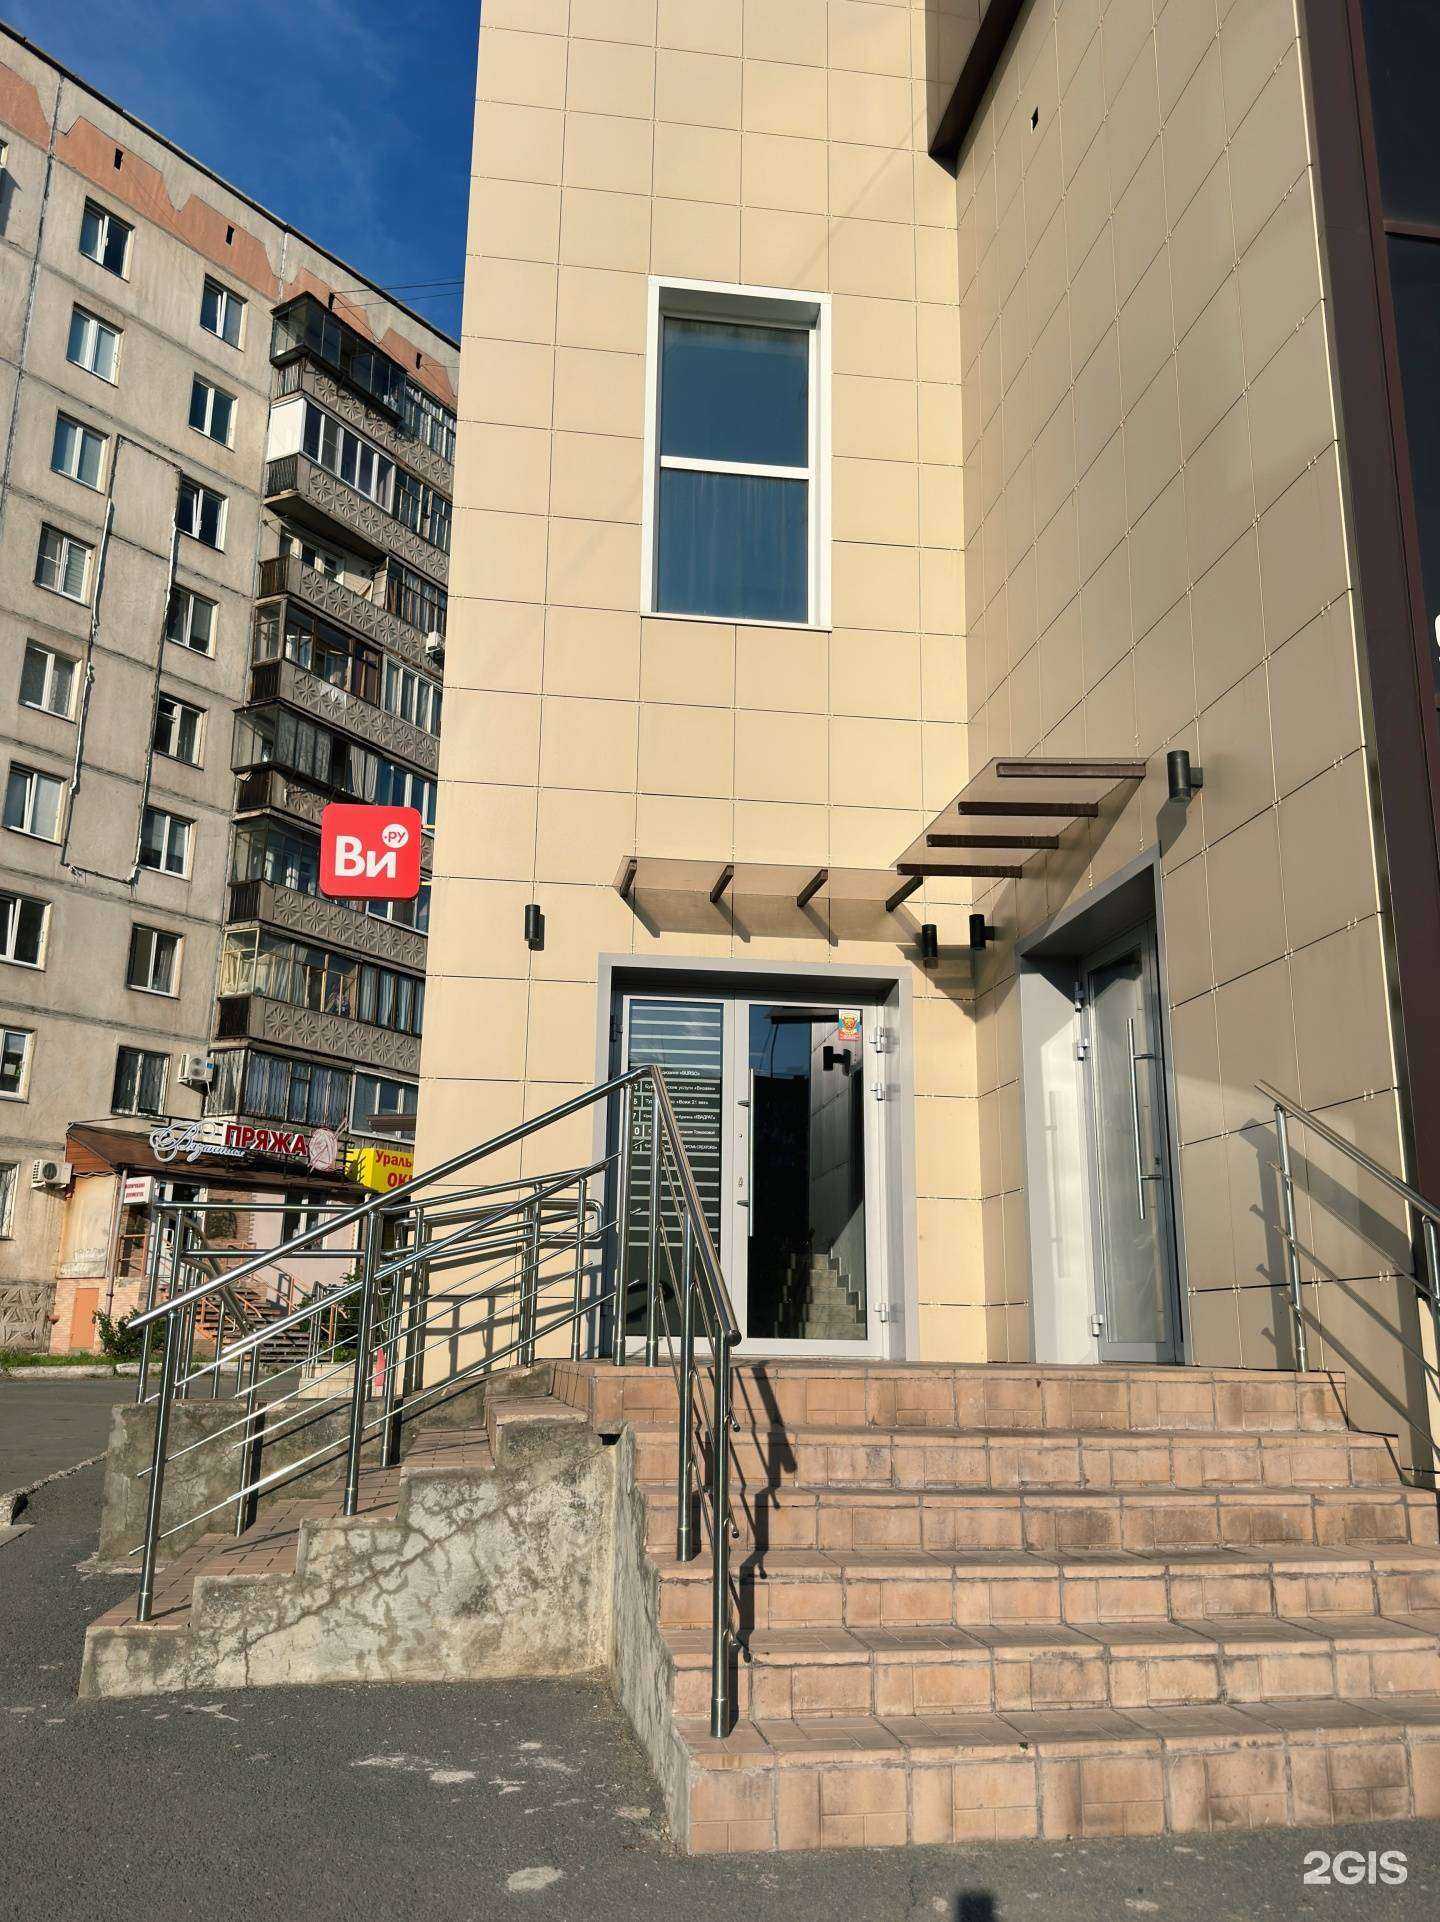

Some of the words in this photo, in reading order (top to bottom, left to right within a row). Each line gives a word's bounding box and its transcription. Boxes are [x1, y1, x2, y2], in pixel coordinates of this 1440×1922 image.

[335, 835, 397, 879] Ви
[225, 1124, 308, 1157] ПРЯЖА
[375, 1150, 413, 1168] Ураль
